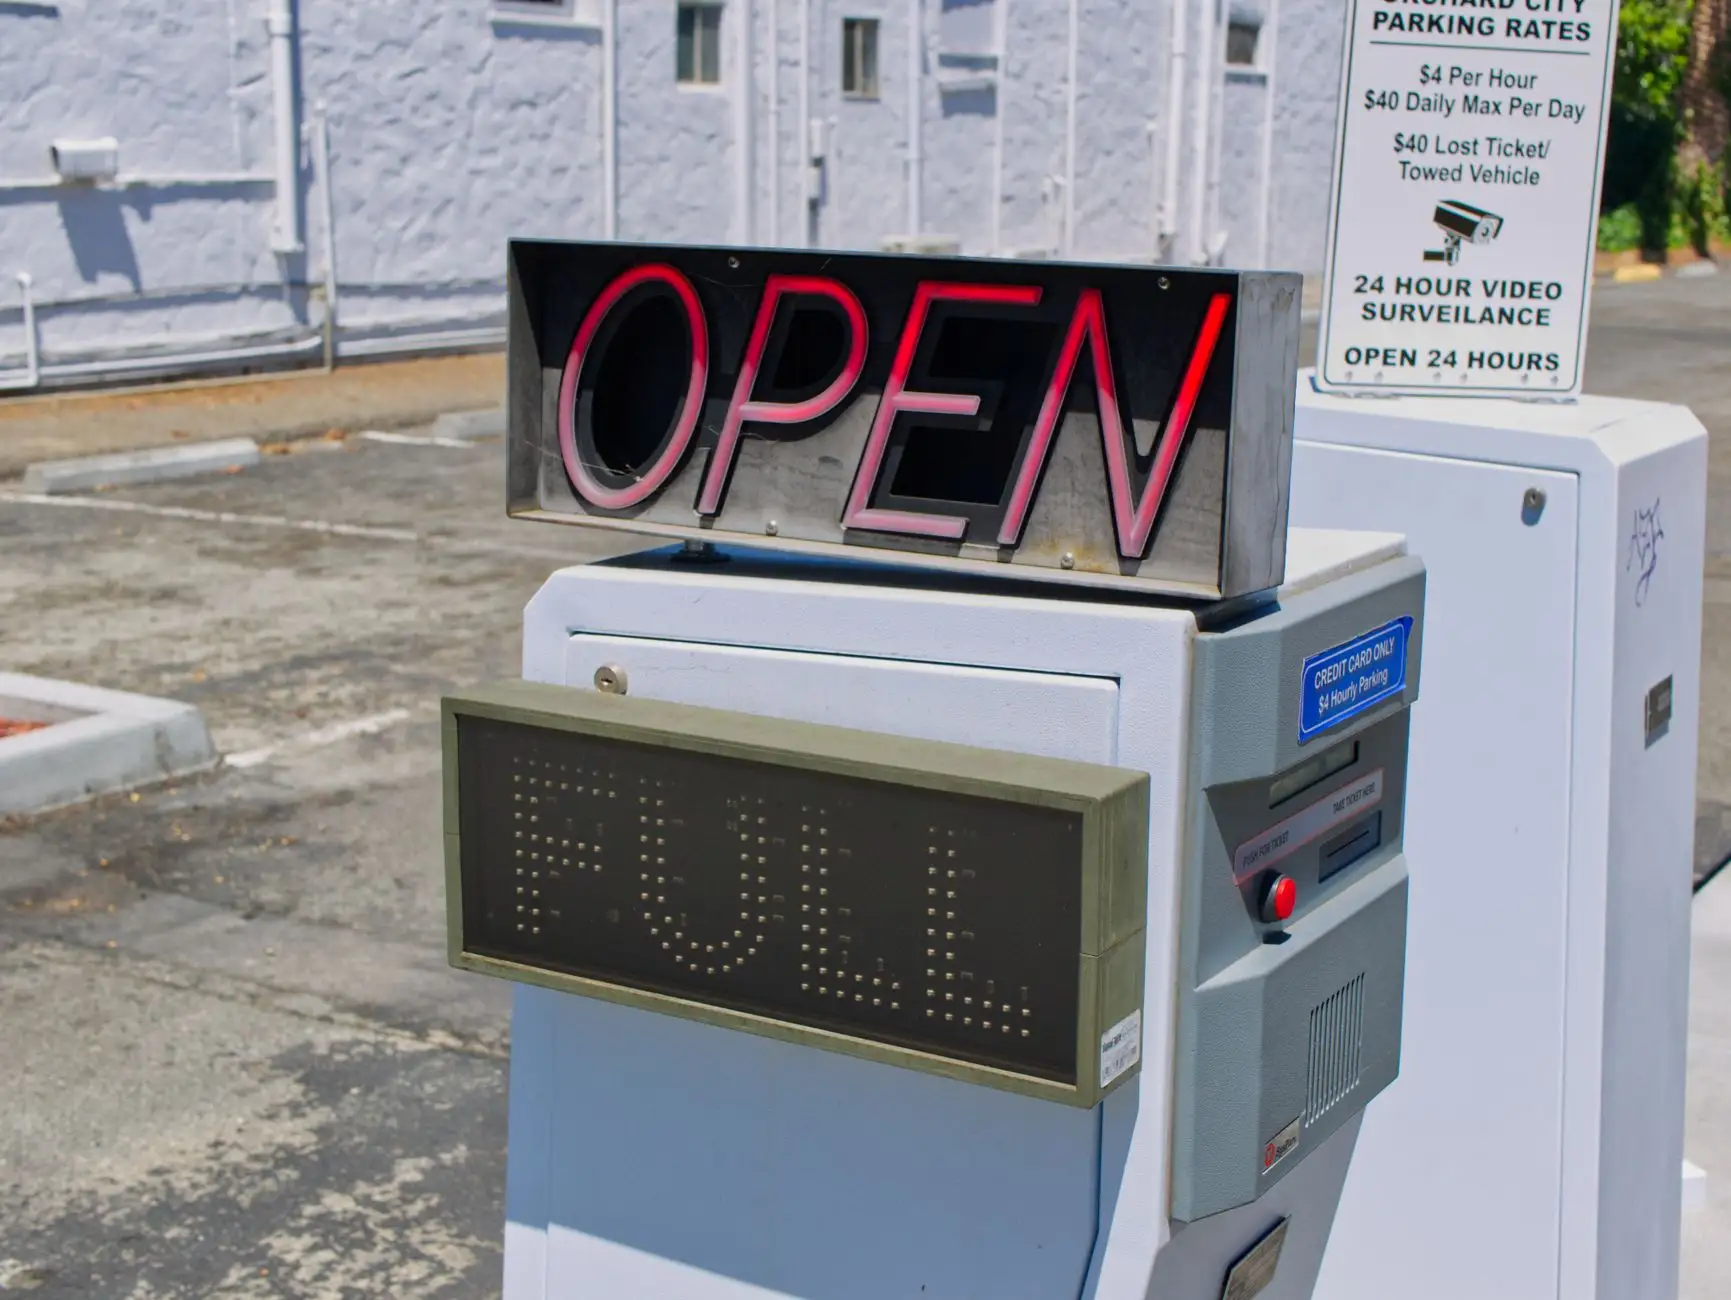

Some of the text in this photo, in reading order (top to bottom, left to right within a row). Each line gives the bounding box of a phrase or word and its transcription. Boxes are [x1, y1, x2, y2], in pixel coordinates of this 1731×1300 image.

[1525, 0, 1586, 13] CITY
[1373, 11, 1591, 41] PARKING RATES
[1419, 64, 1538, 90] $4 Per Hour
[1364, 89, 1586, 124] $40 Daily Max Per Day
[1393, 132, 1551, 159] $40 Lost Ticket/
[1399, 161, 1540, 186] Towed Vehicle
[1354, 275, 1563, 300] 24 HOUR VIDEO
[1361, 302, 1551, 327] SURVEILANCE
[1344, 347, 1560, 372] OPEN 24 HOURS
[559, 263, 1232, 560] OPEN
[1314, 636, 1395, 689] CREDIT CARD ONLY
[1319, 668, 1389, 715] $4 Hourly Parking
[512, 754, 1032, 1038] FULL
